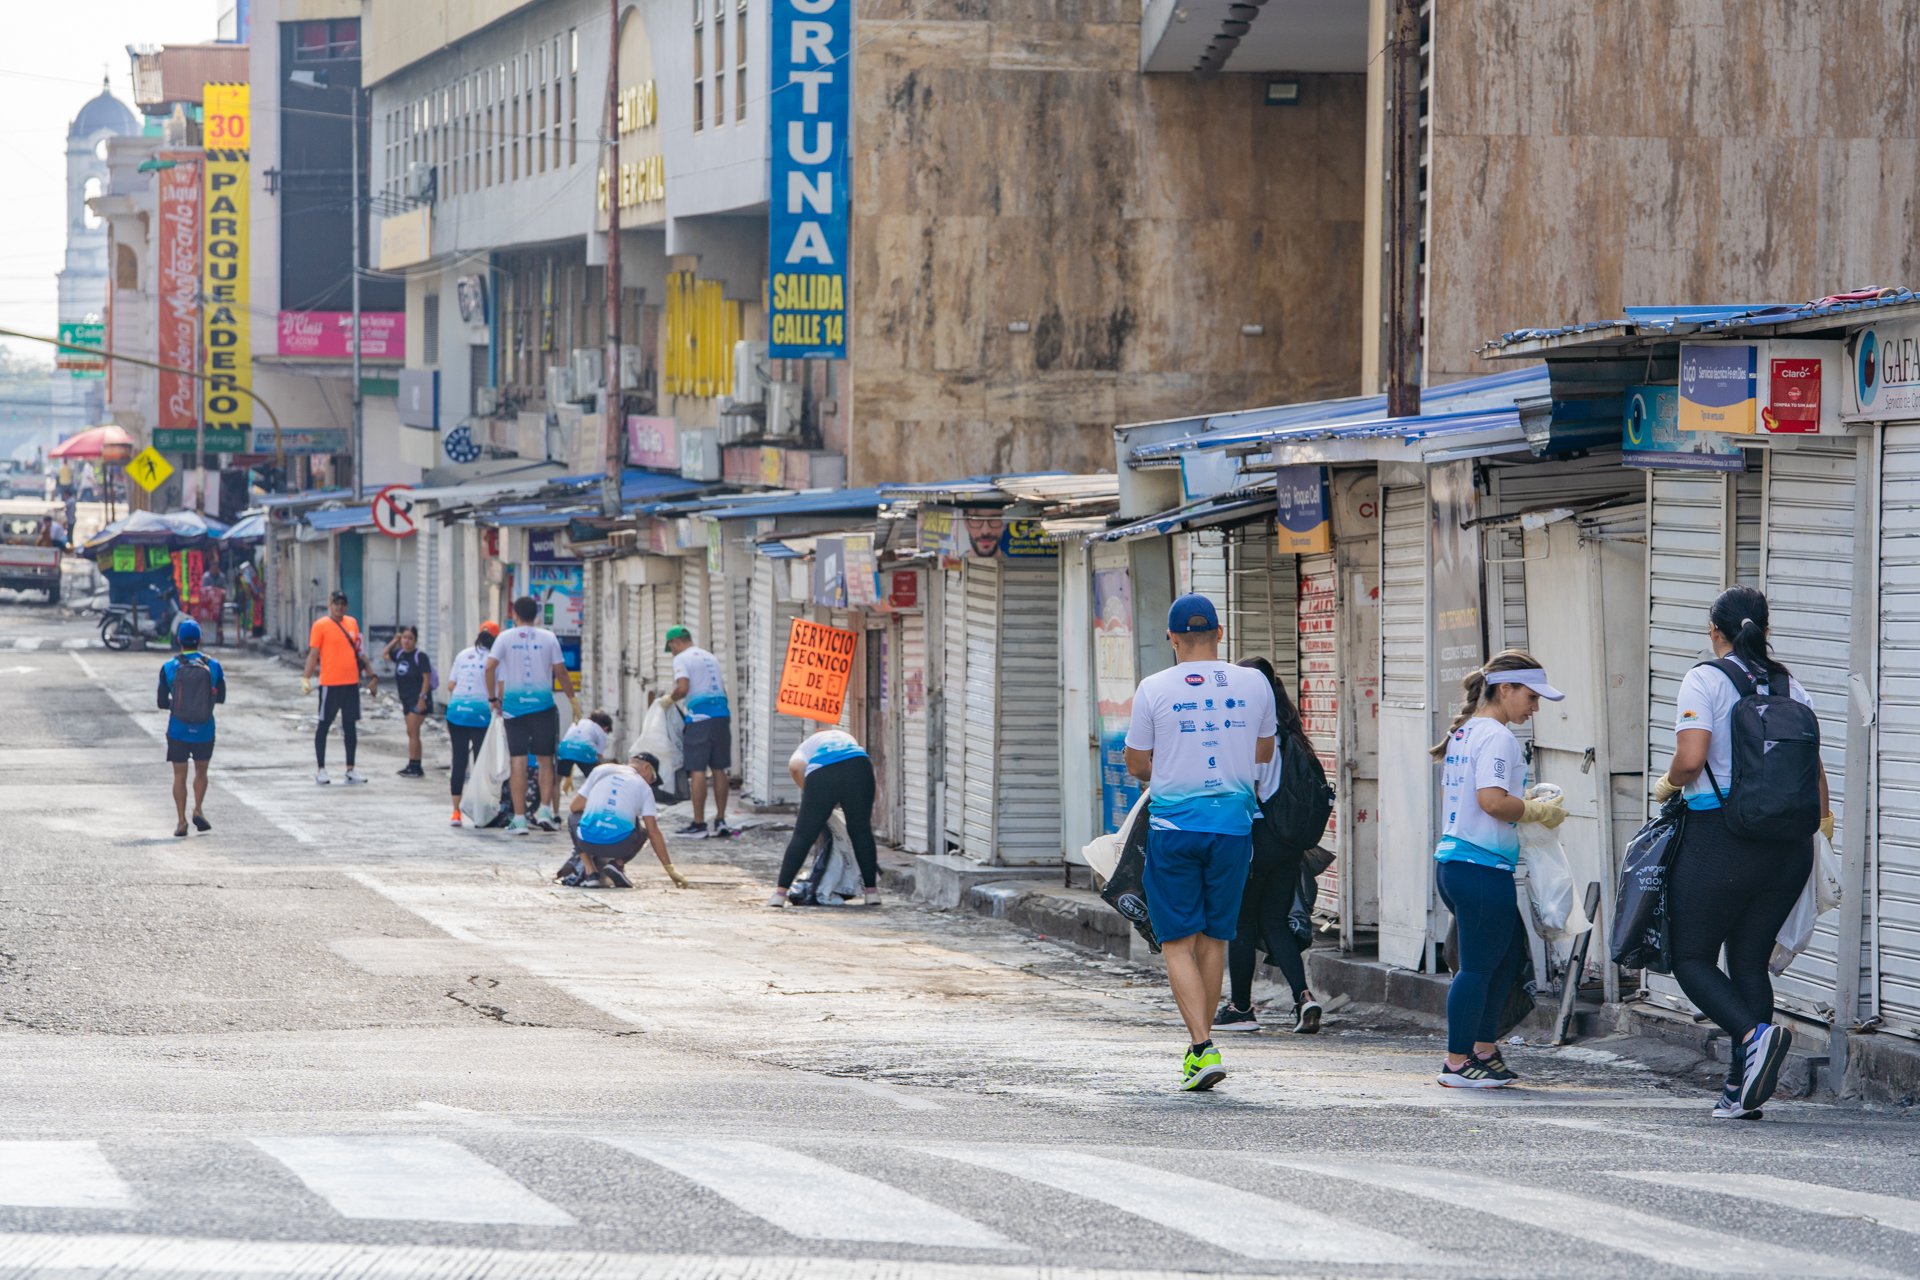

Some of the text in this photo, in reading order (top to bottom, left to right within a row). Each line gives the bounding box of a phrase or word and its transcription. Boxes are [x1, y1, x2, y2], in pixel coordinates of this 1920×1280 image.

[617, 79, 657, 133] ENTRO
[208, 114, 245, 138] 30
[207, 173, 239, 414] PARQUEADERO
[773, 273, 844, 310] SALIDA
[772, 313, 844, 345] CALLE 14
[1698, 366, 1714, 380] Servicio
[1781, 367, 1809, 379] Claro
[174, 432, 242, 448] serventrega
[1446, 607, 1478, 630] TECHNOLOGY
[793, 623, 854, 655] SERVICIO
[790, 647, 849, 674] TECNICO
[806, 672, 824, 690] DE
[780, 689, 841, 715] CELULARES
[1640, 865, 1667, 877] iclar
[1639, 885, 1660, 893] PONGA
